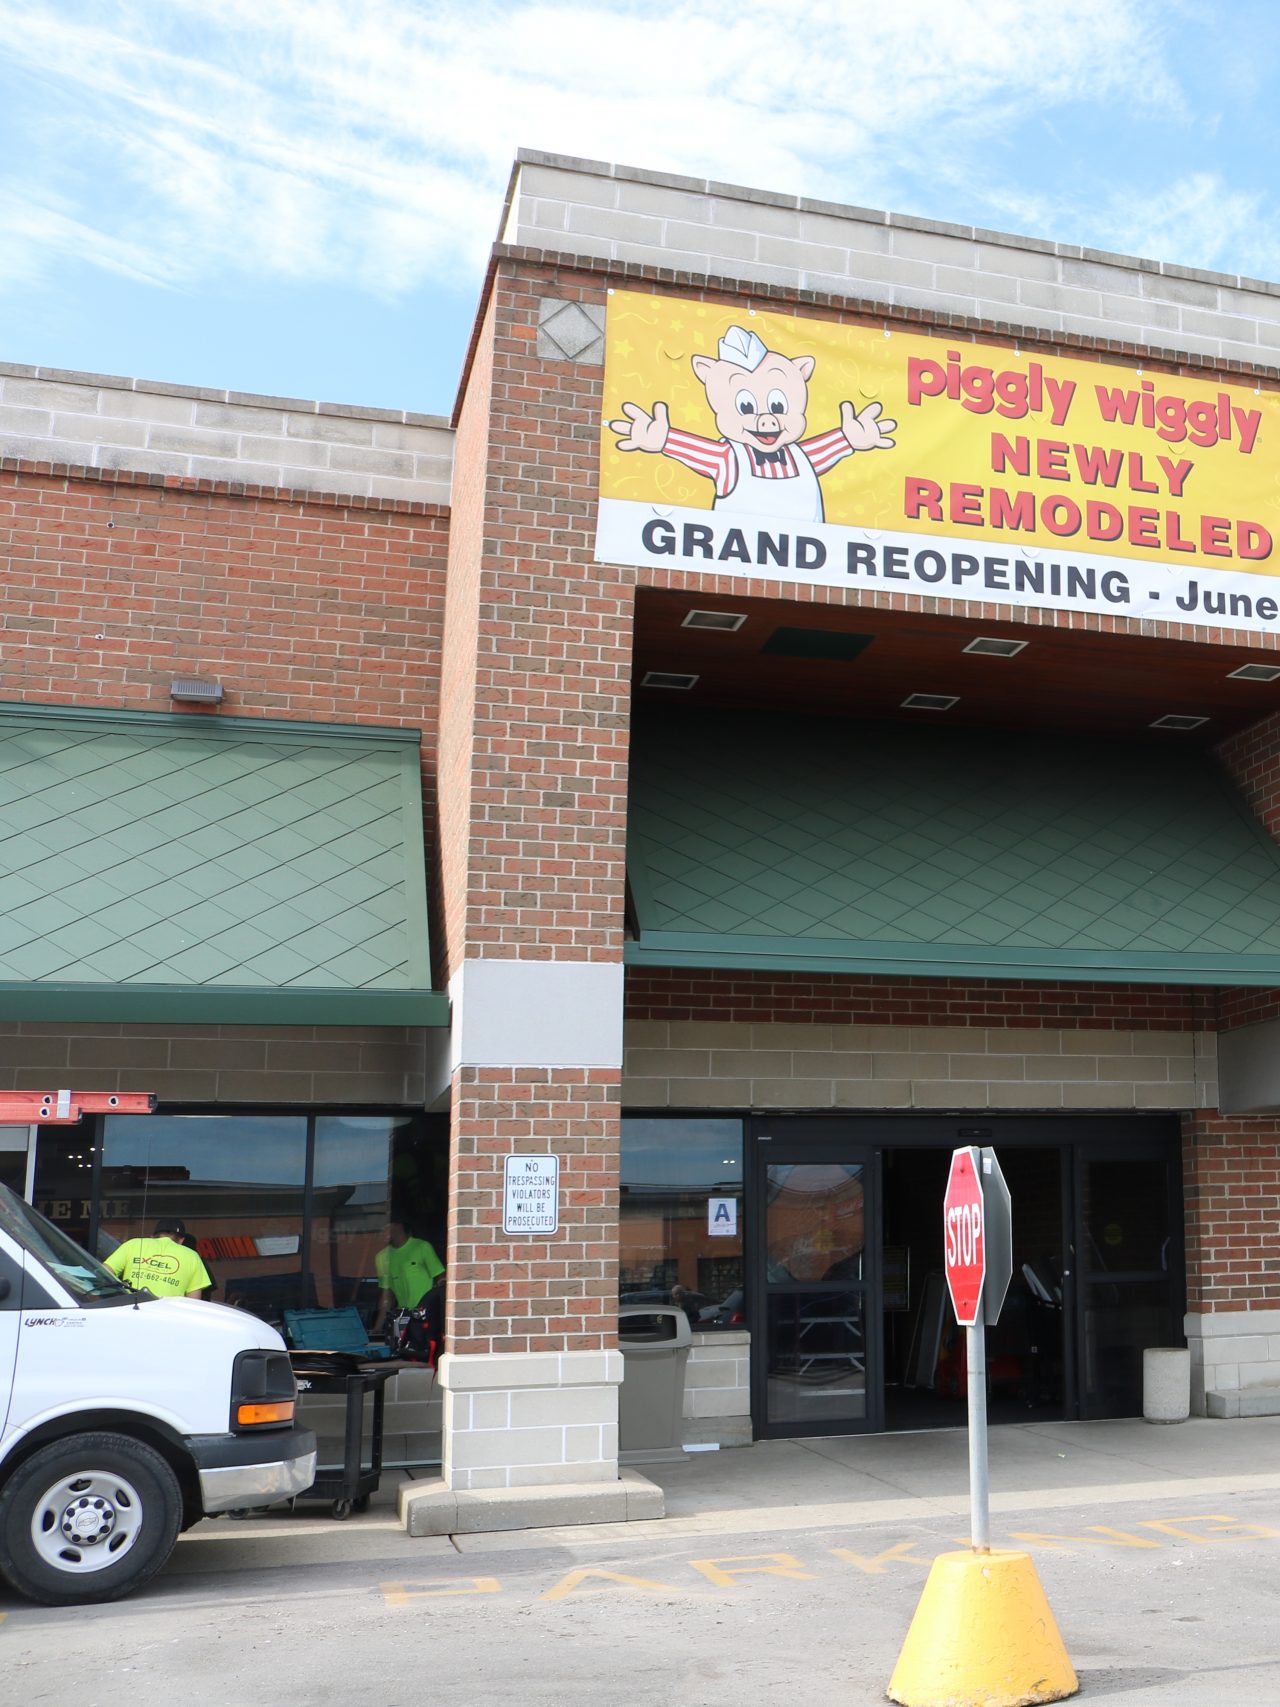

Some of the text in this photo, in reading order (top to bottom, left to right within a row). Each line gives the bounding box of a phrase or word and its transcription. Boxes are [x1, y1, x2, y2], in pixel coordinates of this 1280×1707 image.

[907, 350, 1262, 454] piggly wiggly
[990, 432, 1193, 497] NEWLY
[903, 476, 1274, 560] REMODELED
[641, 519, 828, 571] GRAND
[846, 541, 1131, 604] REOPENING
[1175, 580, 1279, 621] June
[525, 1162, 539, 1172] NO
[508, 1175, 555, 1186] TRESPASSING
[512, 1189, 551, 1199] VIOLATORS
[516, 1202, 546, 1213] WILL BE
[714, 1203, 731, 1222] A
[507, 1216, 554, 1226] PROSECUTED
[947, 1203, 981, 1267] STOP
[133, 1257, 172, 1270] EXCEL
[24, 1317, 55, 1327] LYNCH
